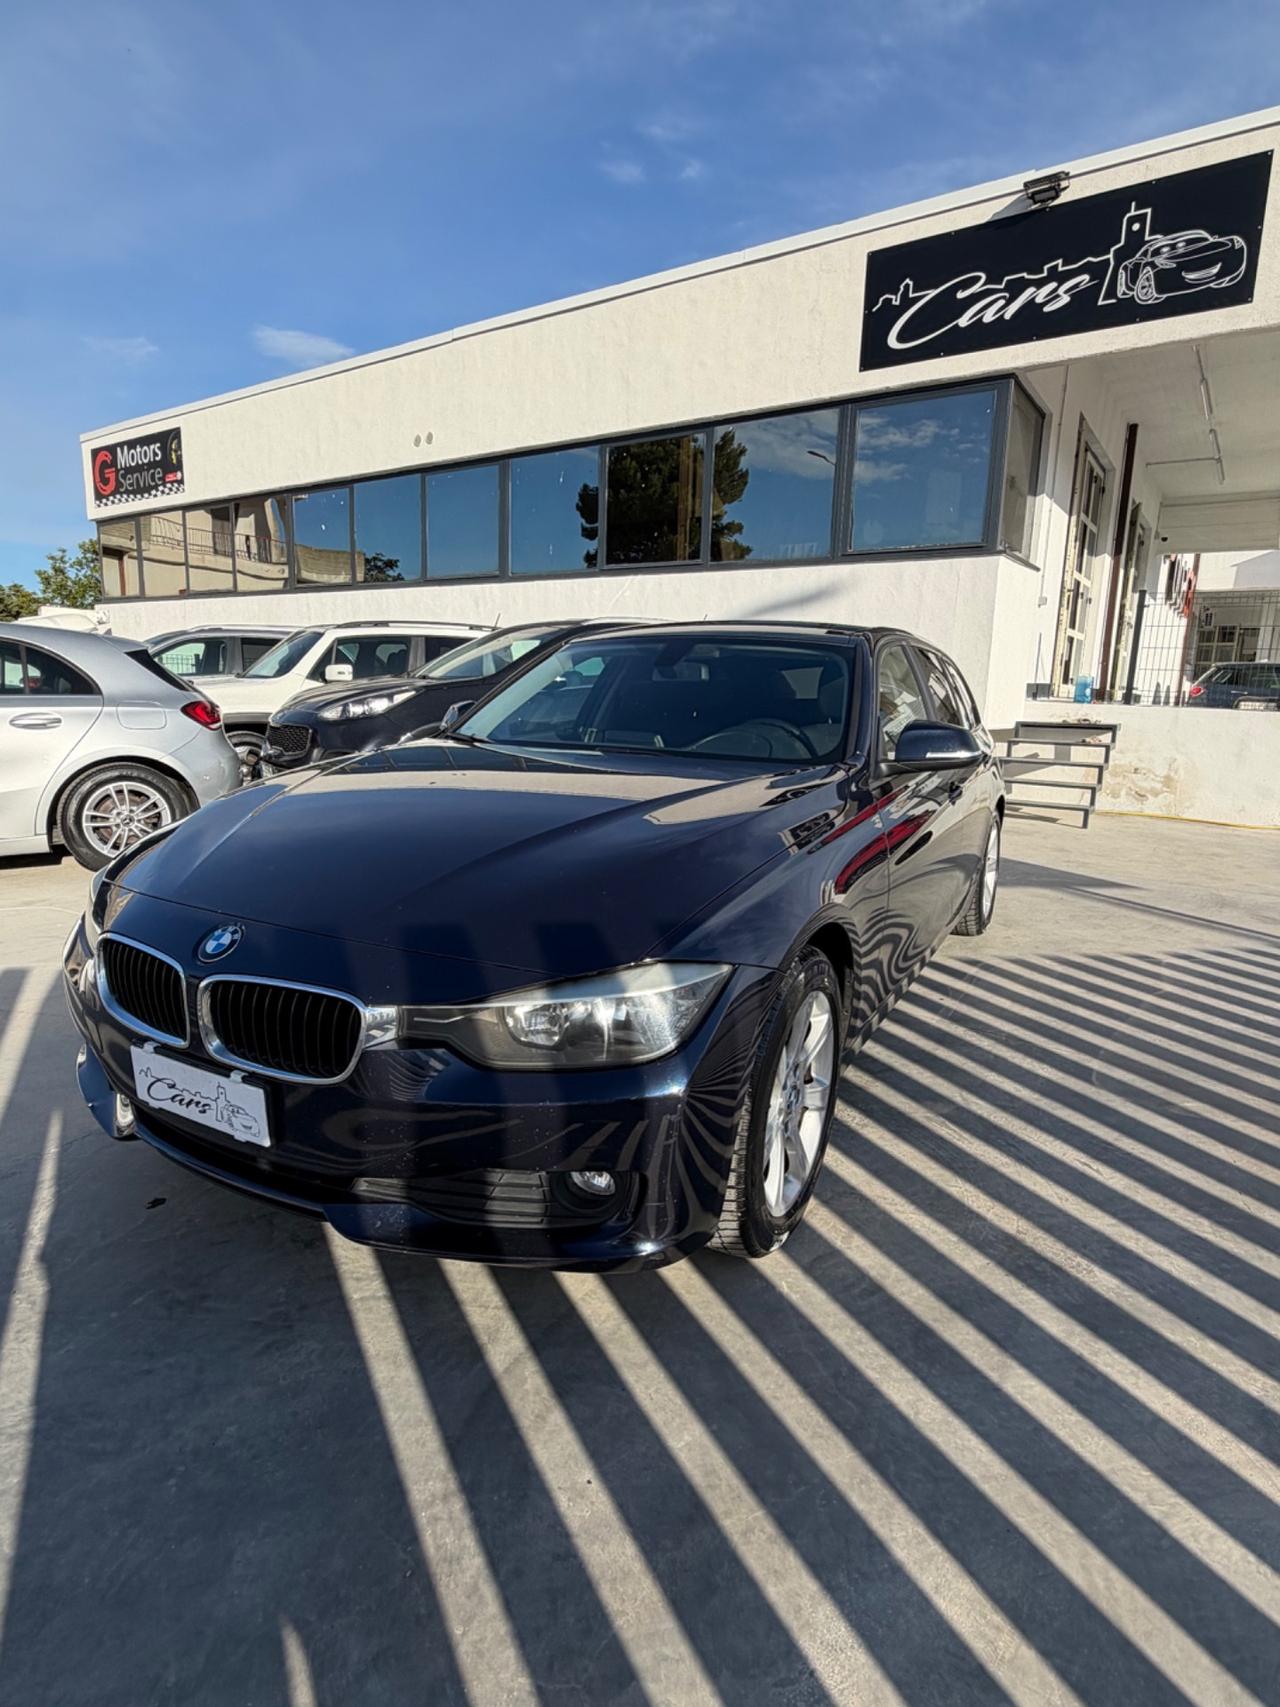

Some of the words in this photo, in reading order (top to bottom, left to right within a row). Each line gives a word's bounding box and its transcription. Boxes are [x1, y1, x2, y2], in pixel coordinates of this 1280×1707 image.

[888, 272, 1099, 349] Cars
[94, 450, 117, 495] G
[117, 443, 161, 469] Motors
[118, 466, 163, 491] Service
[147, 1078, 214, 1114] Cars
